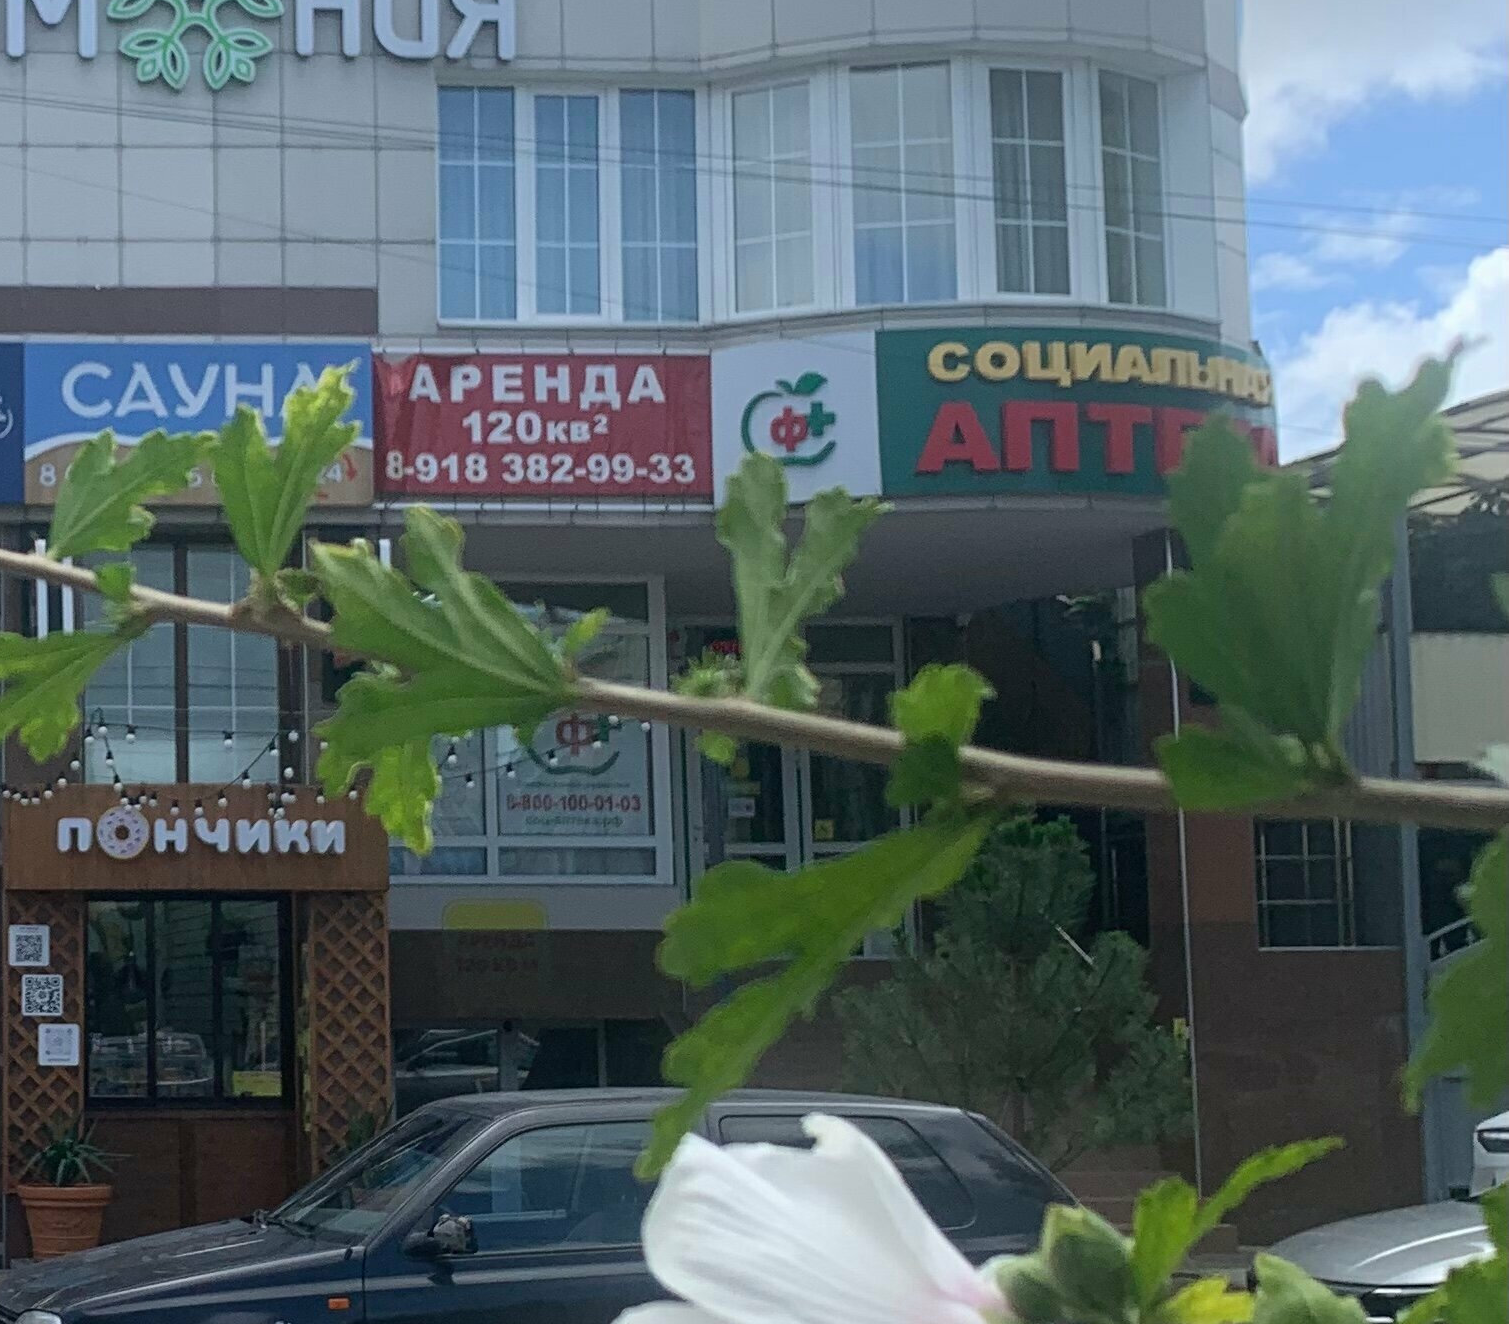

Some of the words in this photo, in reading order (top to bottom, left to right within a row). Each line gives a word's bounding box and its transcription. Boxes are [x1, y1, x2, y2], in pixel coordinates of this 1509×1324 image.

[408, 363, 665, 411] АРЕНДА
[386, 451, 488, 483] 8-918
[502, 452, 696, 484] 382-99-33
